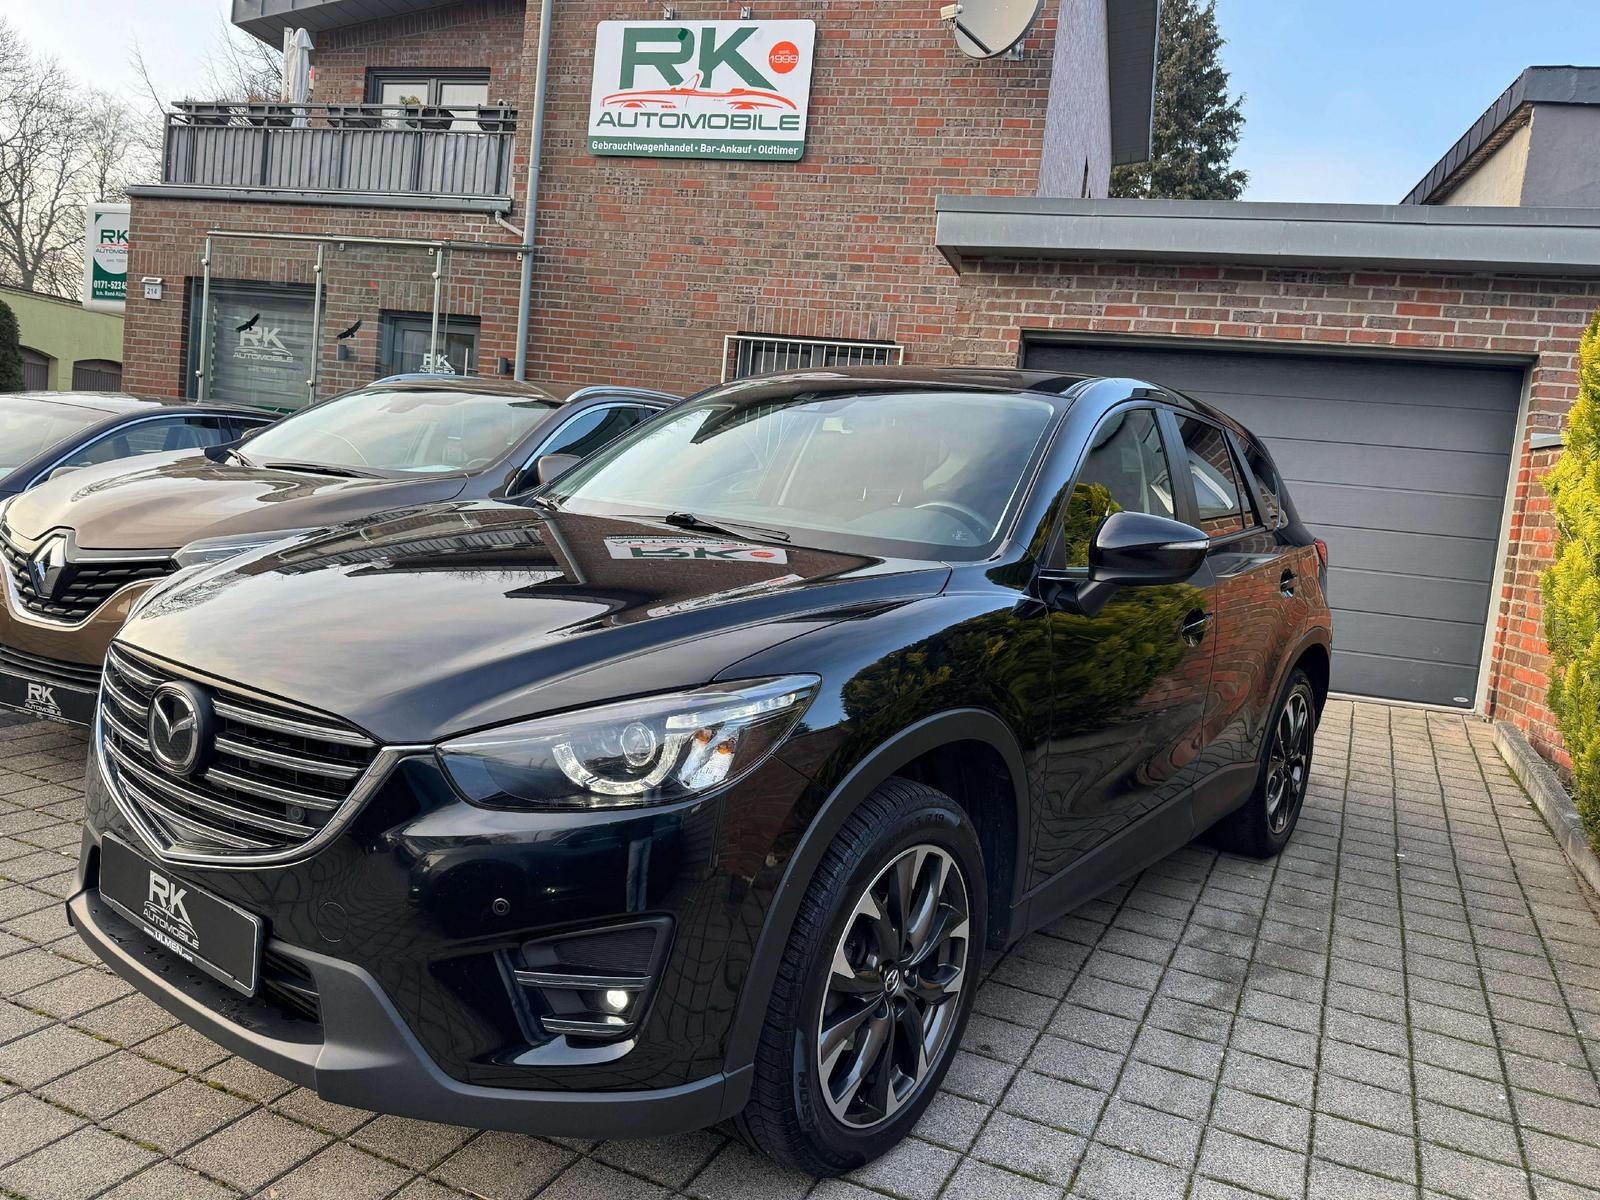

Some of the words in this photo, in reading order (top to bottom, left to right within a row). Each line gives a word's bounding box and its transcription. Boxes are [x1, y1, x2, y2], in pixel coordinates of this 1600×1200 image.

[619, 27, 779, 92] RK
[769, 54, 799, 65] 1999
[596, 111, 800, 131] AUTOMOBILE
[592, 140, 694, 154] Gebrauchtwagenhandel
[699, 143, 753, 154] Bar-Ankauf
[758, 145, 799, 155] Oldtimer
[101, 230, 128, 244] RK
[239, 327, 286, 349] RK
[232, 351, 294, 363] AUTOMOBILE
[27, 682, 57, 706] RK
[24, 702, 62, 717] AUTOMOBILE
[148, 869, 193, 927] RK
[142, 907, 200, 950] AUTOMOBILE
